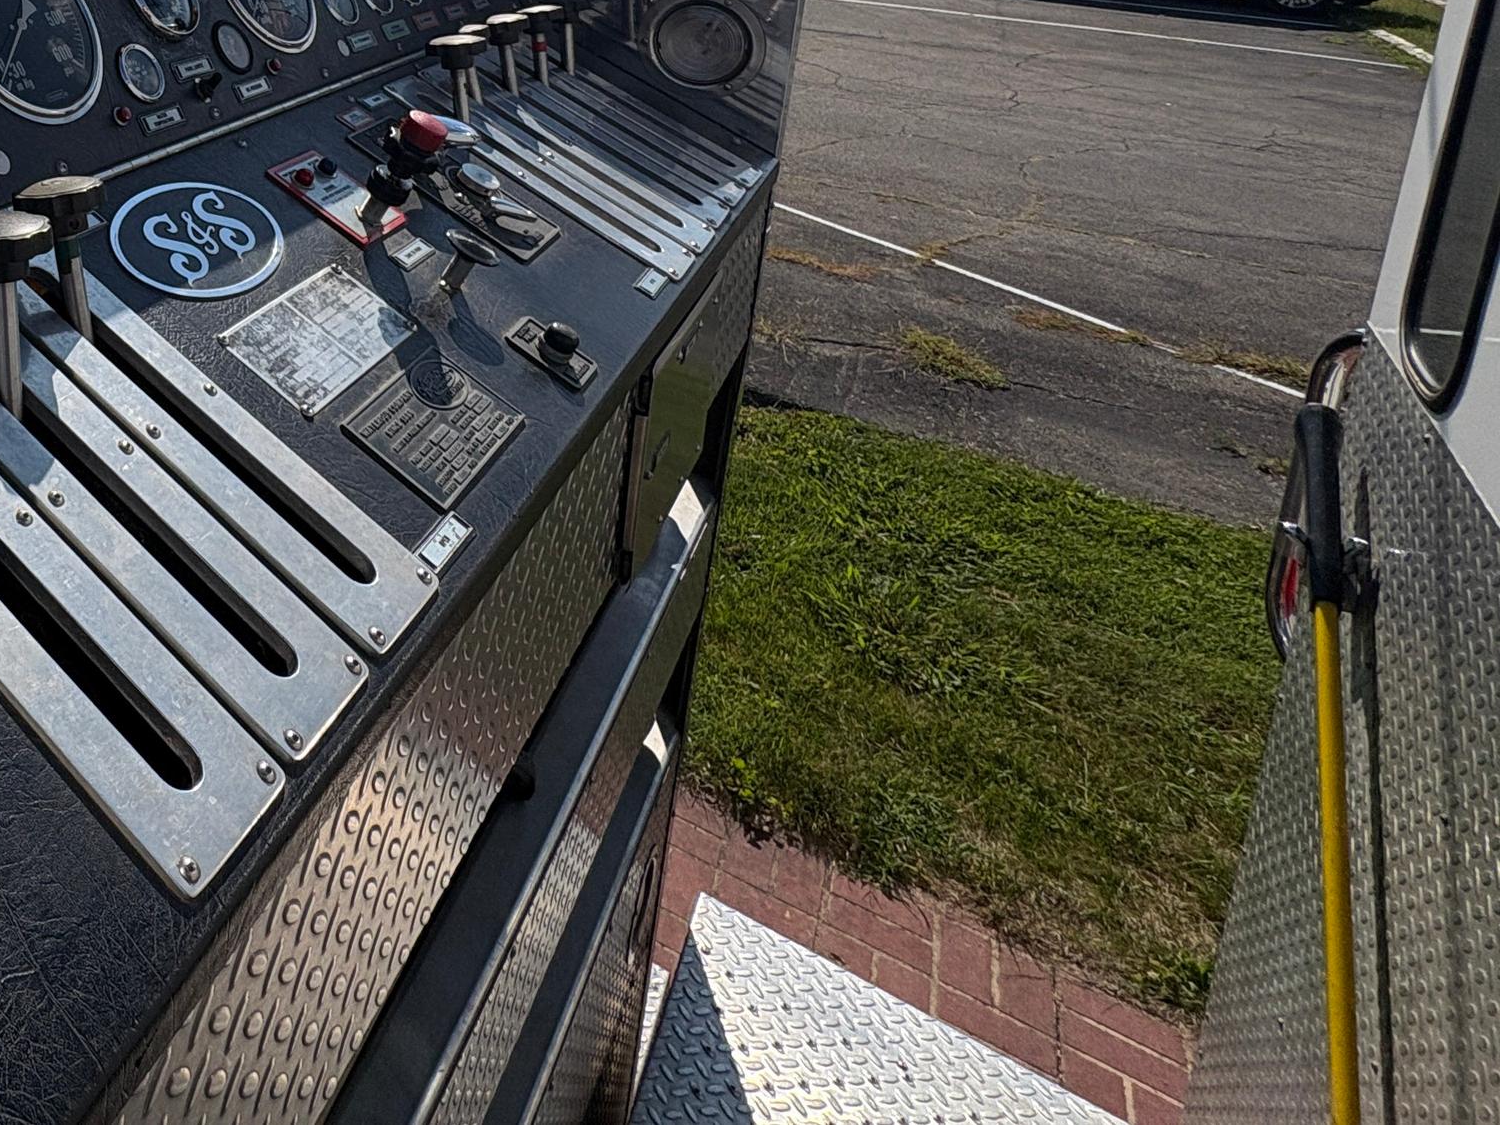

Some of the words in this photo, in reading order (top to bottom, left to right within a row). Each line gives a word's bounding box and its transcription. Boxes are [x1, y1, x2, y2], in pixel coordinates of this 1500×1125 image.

[44, 9, 66, 26] 500
[52, 43, 74, 62] 600
[143, 191, 257, 288] S&S
